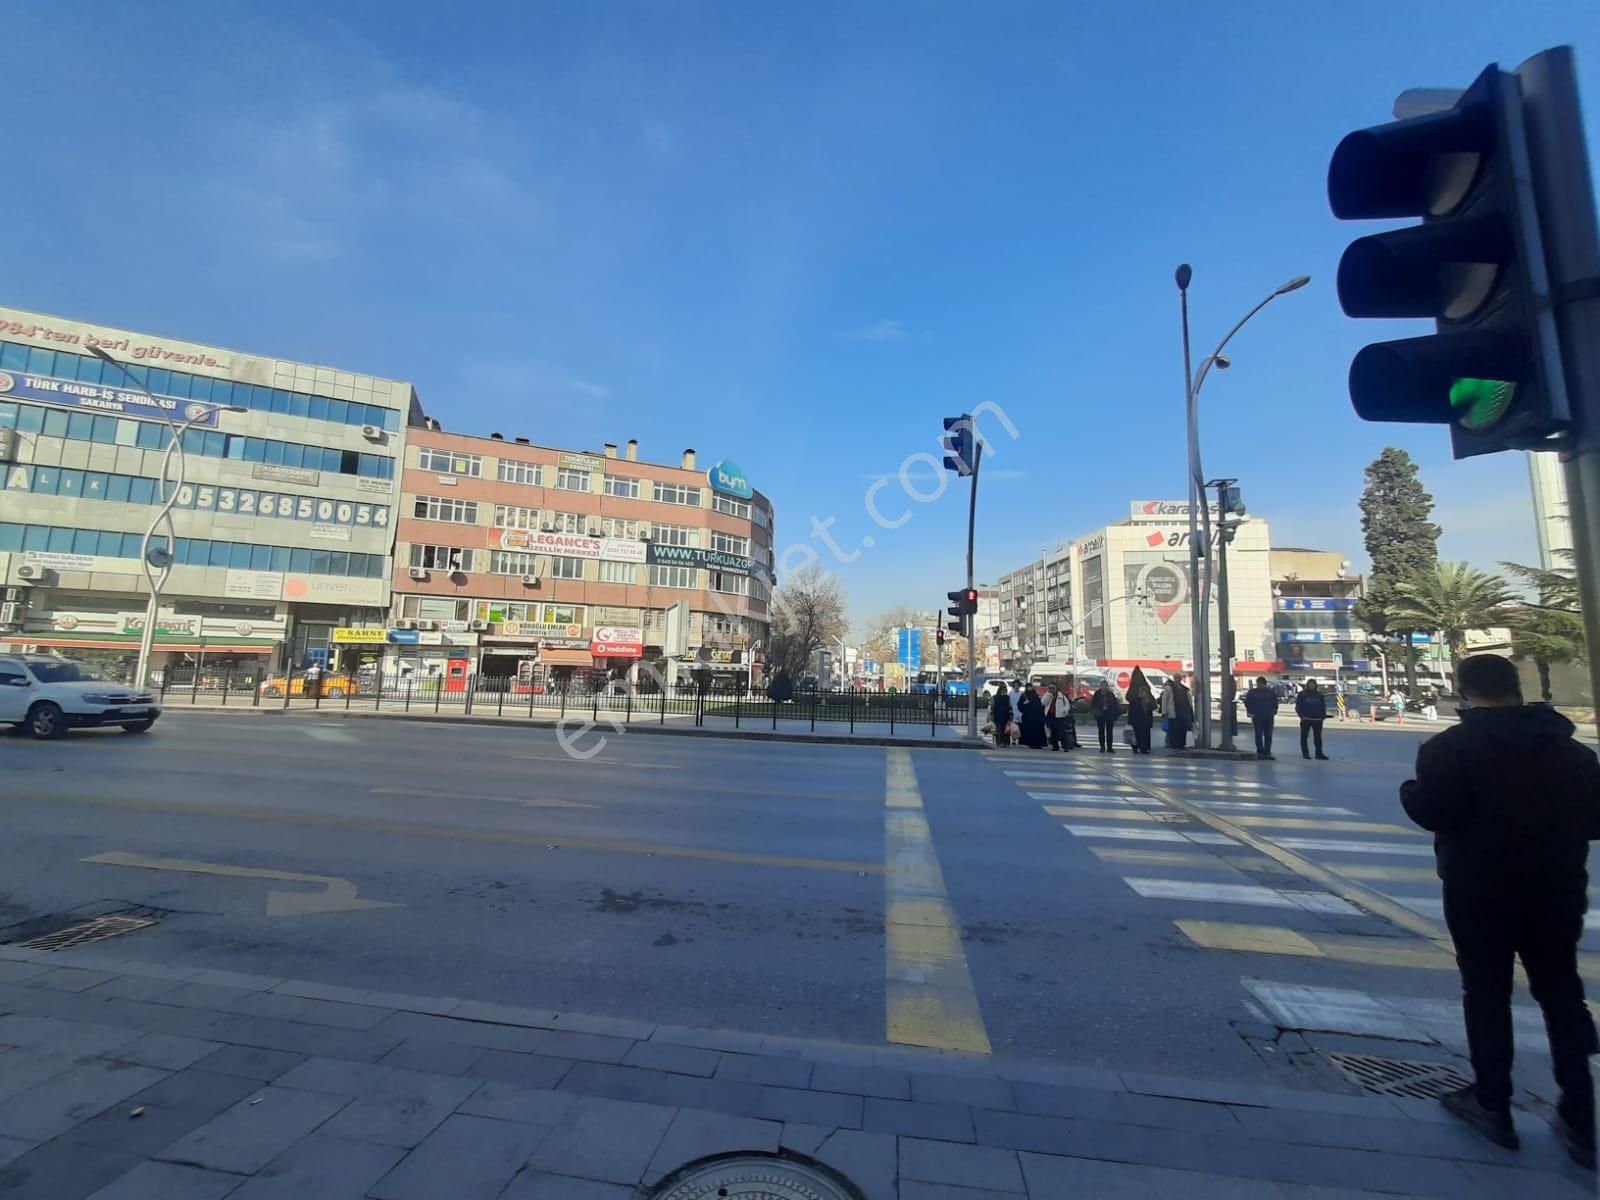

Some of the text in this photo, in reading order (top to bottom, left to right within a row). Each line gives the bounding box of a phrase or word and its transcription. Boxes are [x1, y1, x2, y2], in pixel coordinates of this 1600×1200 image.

[84, 334, 130, 351] beri
[24, 377, 59, 392] TÜRK
[63, 385, 114, 401] HARB-İŞ
[79, 398, 124, 411] SAKARYA
[719, 473, 746, 489] bym
[177, 485, 389, 526] 05326850054
